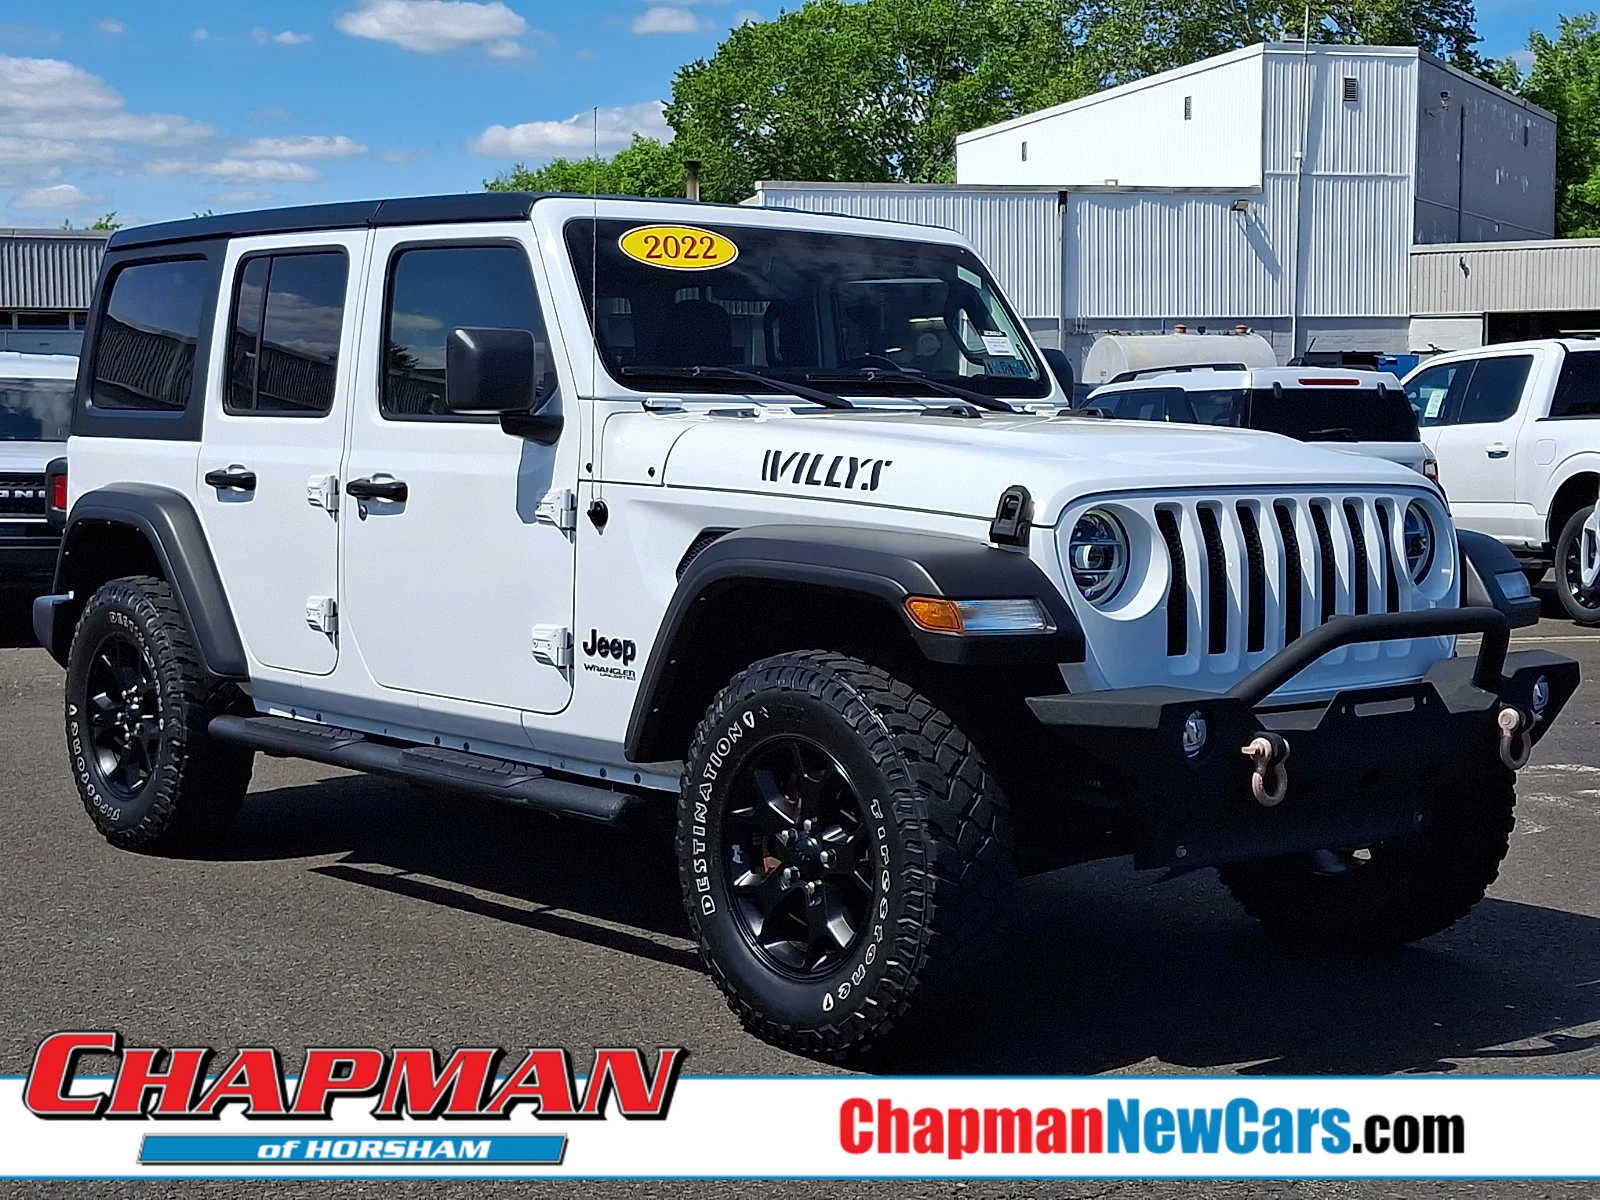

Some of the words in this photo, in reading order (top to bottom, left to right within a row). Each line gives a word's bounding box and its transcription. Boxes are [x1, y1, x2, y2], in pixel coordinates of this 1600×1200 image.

[643, 234, 718, 259] 2022
[761, 449, 893, 492] WILLYS
[582, 628, 637, 667] Jeep
[583, 662, 636, 679] WRANGLER
[692, 720, 743, 916] DESTINATION
